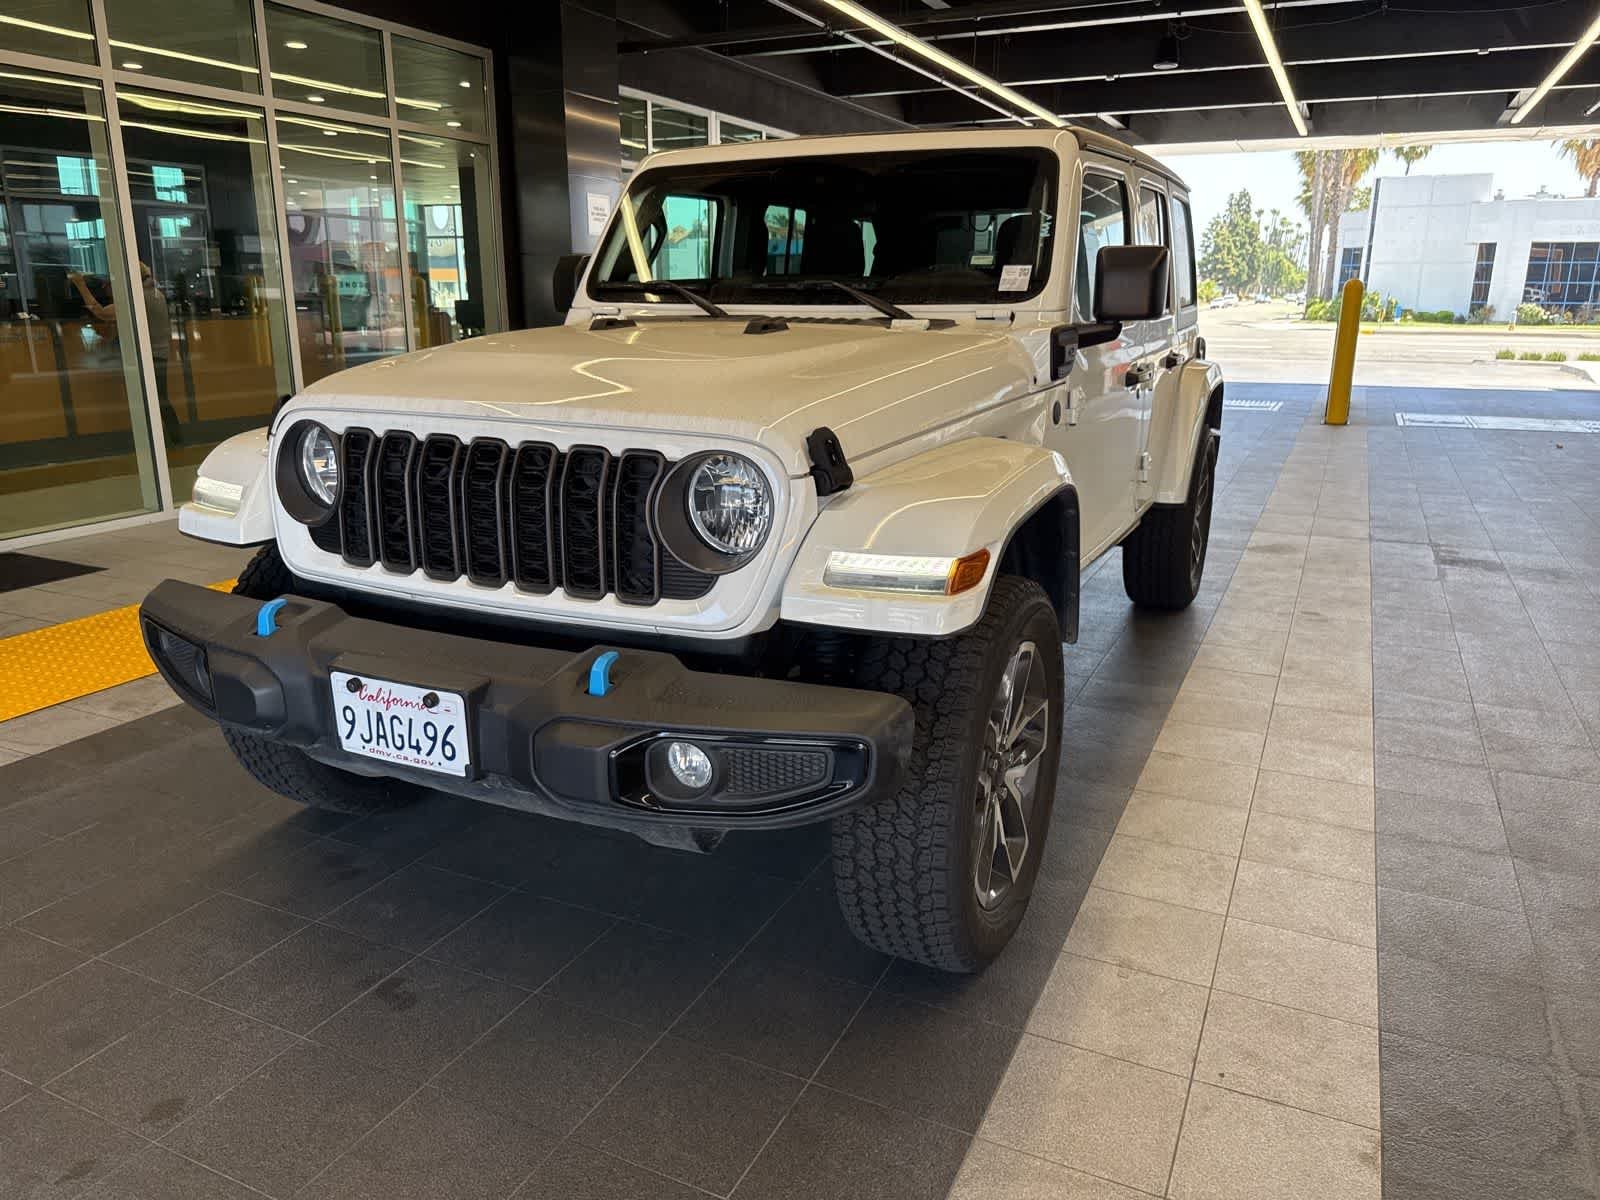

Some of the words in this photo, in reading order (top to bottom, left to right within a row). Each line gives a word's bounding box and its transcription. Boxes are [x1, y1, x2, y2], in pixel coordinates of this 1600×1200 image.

[357, 683, 438, 714] California
[342, 705, 456, 762] 9JAG496
[368, 747, 435, 767] dmv.ca.gov
